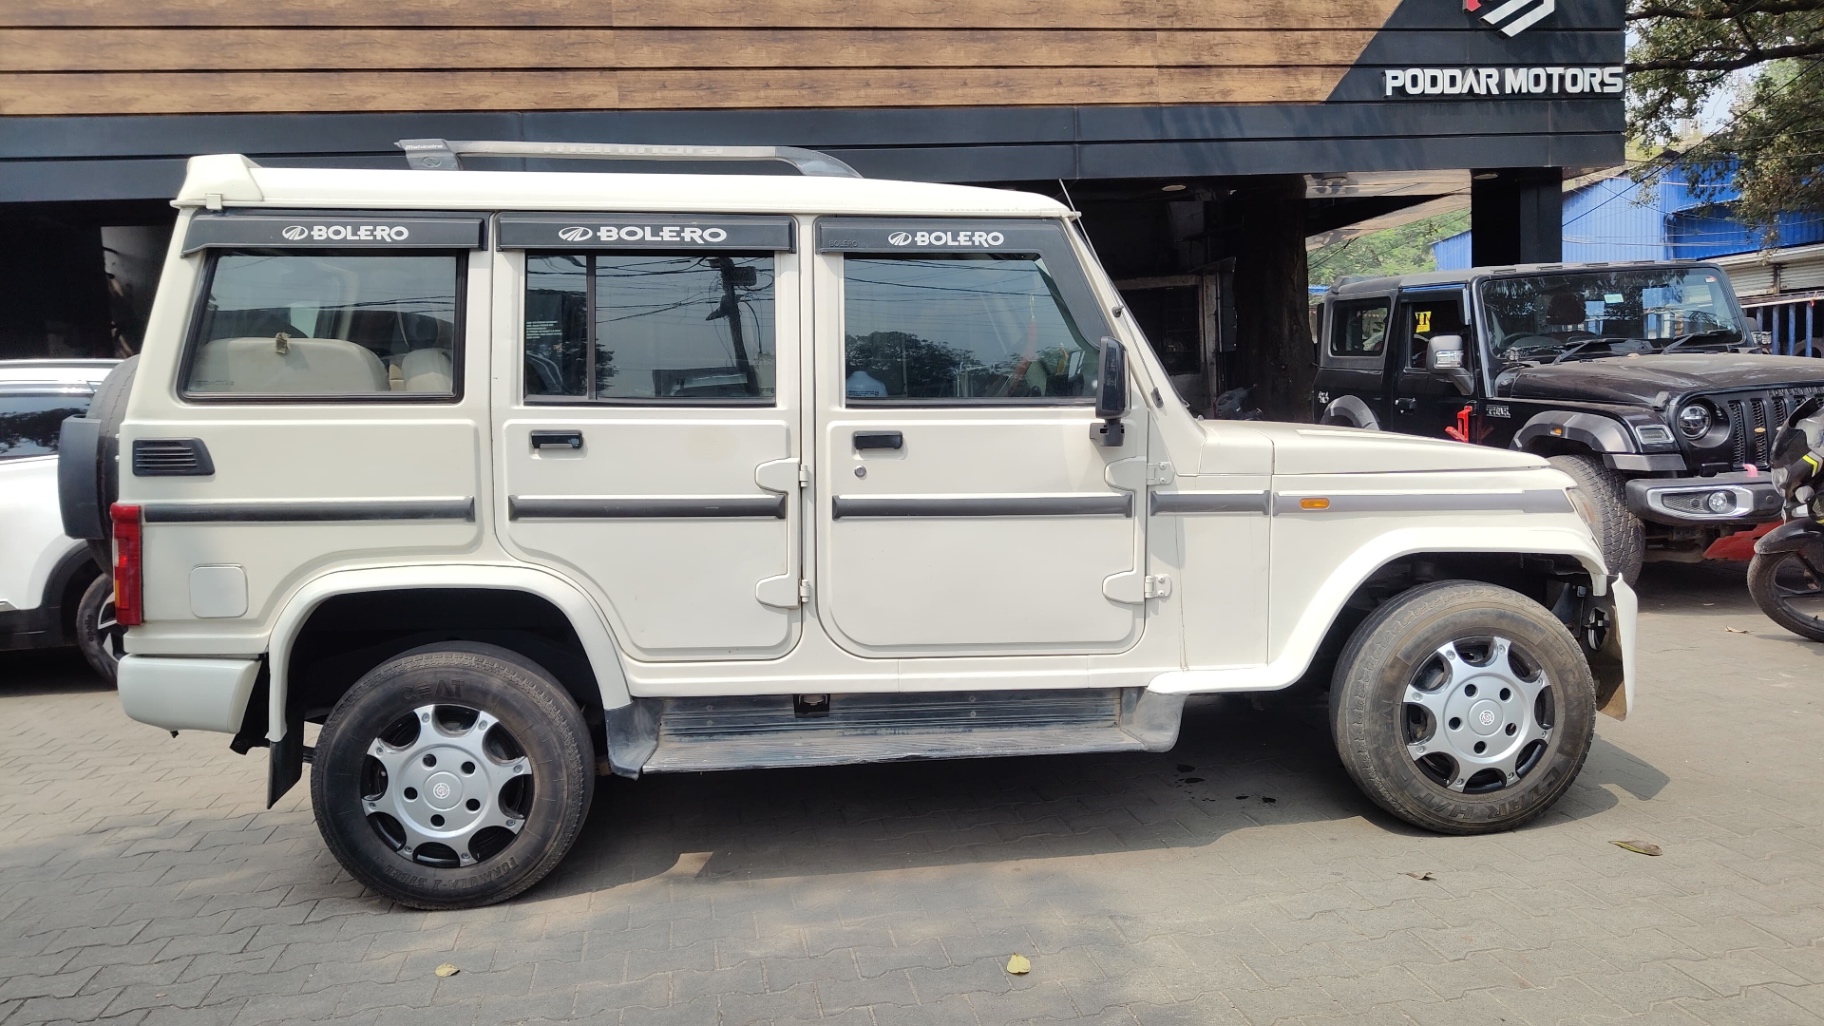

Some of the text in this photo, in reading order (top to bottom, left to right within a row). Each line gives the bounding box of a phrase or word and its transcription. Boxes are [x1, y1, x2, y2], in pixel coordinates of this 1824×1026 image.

[1384, 66, 1624, 96] PODDAR MOTORS
[310, 225, 409, 242] BOLERO
[596, 226, 728, 244] BOLERO
[914, 231, 1005, 247] BOLERO
[400, 679, 465, 700] CEAT
